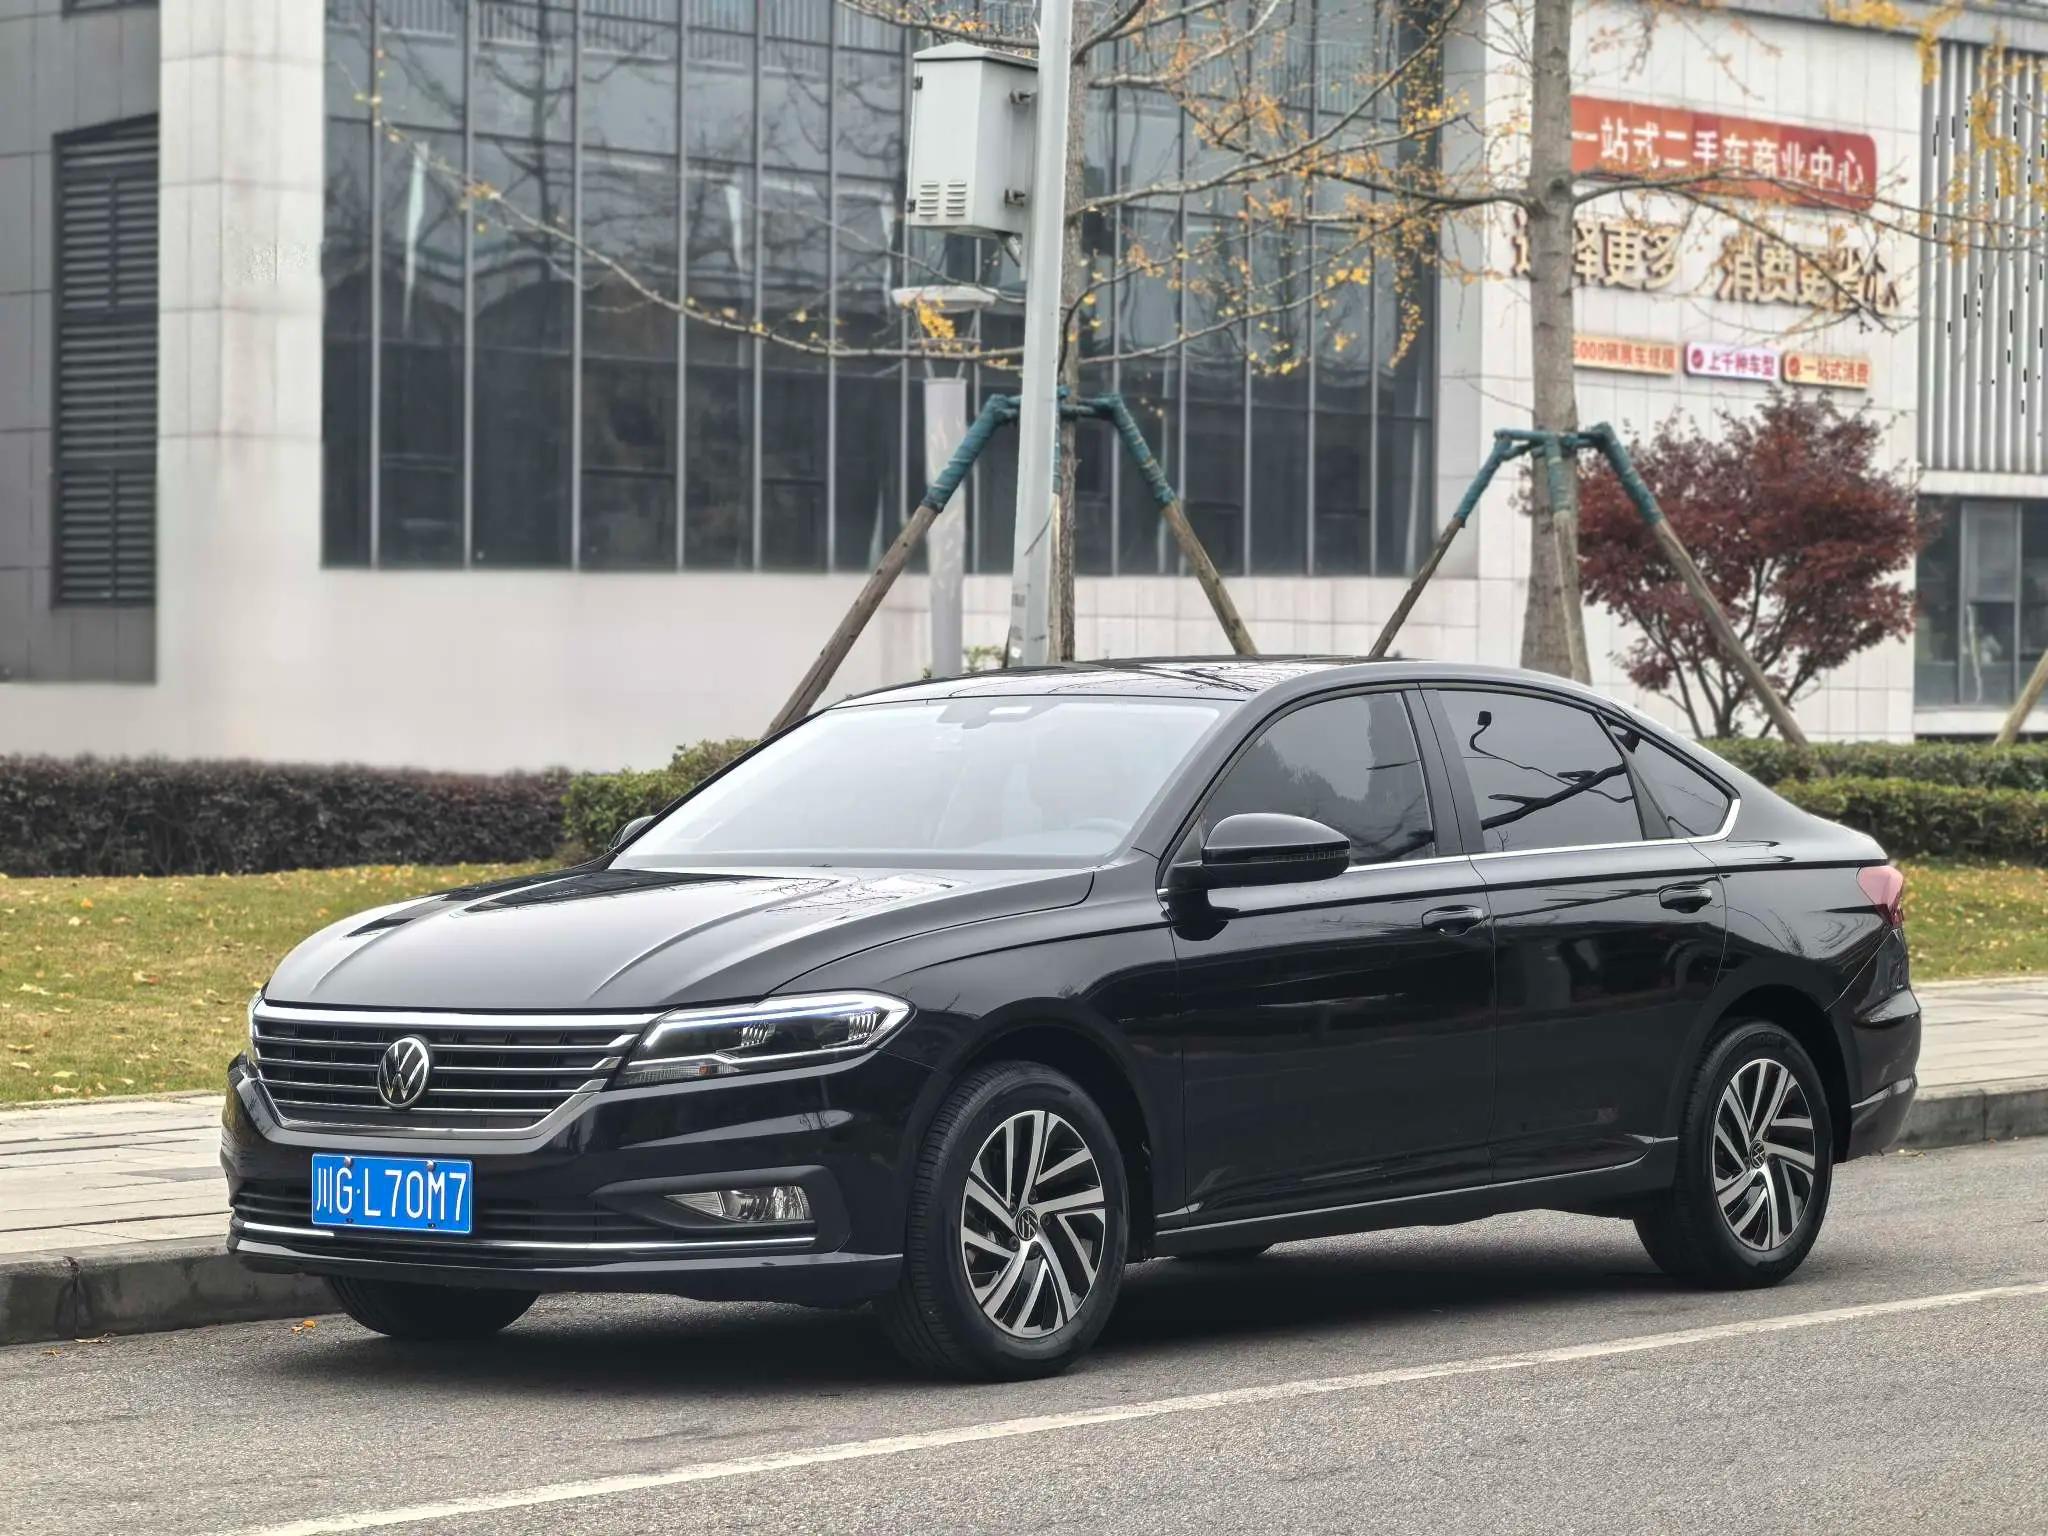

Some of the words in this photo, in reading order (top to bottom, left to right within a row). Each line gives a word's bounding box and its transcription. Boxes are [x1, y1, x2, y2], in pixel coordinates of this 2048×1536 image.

[1571, 117, 1864, 191] 一站式二手车商业中心
[1512, 206, 1684, 291] 择更多
